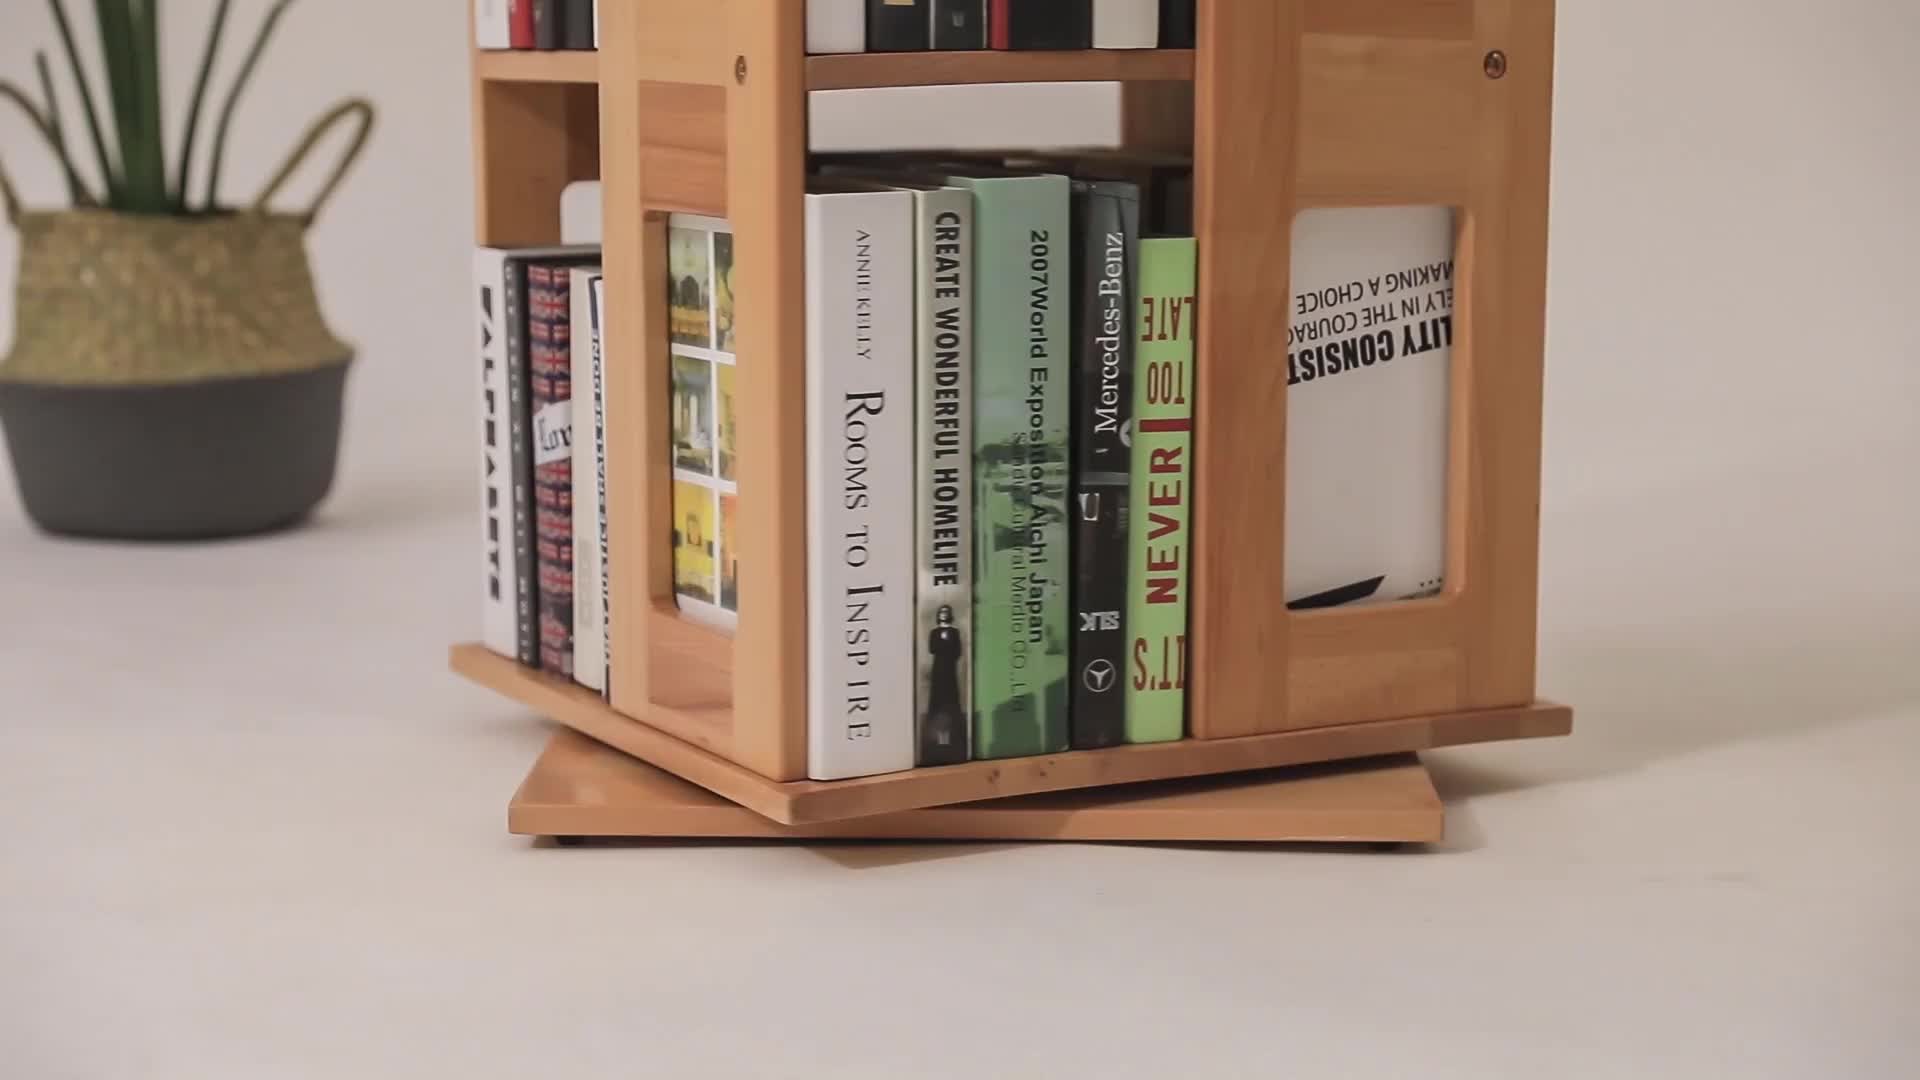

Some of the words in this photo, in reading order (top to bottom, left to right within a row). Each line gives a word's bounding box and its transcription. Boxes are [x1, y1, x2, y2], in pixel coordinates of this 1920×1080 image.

[856, 229, 872, 293] ANNIE
[935, 211, 960, 299] CREATE
[1029, 230, 1048, 359] 2007World
[1296, 281, 1364, 315] CHOICE
[1363, 301, 1398, 328] THE
[1367, 276, 1381, 297] A
[1402, 296, 1420, 318] IN
[856, 298, 872, 360] KELLY
[1094, 232, 1124, 434] Mercedes-Benz
[1141, 297, 1193, 342] LATE
[933, 307, 960, 459] WONDERFUL
[1146, 361, 1185, 405] TOO
[1287, 329, 1395, 386] CONSIST
[1026, 366, 1048, 497] Exposition
[845, 525, 869, 568] TO
[933, 468, 960, 587] HOMELIFE
[1029, 503, 1048, 564] Aichi
[1145, 446, 1183, 604] NEVER
[1025, 571, 1048, 644] Japan
[1134, 635, 1185, 691] IT'S
